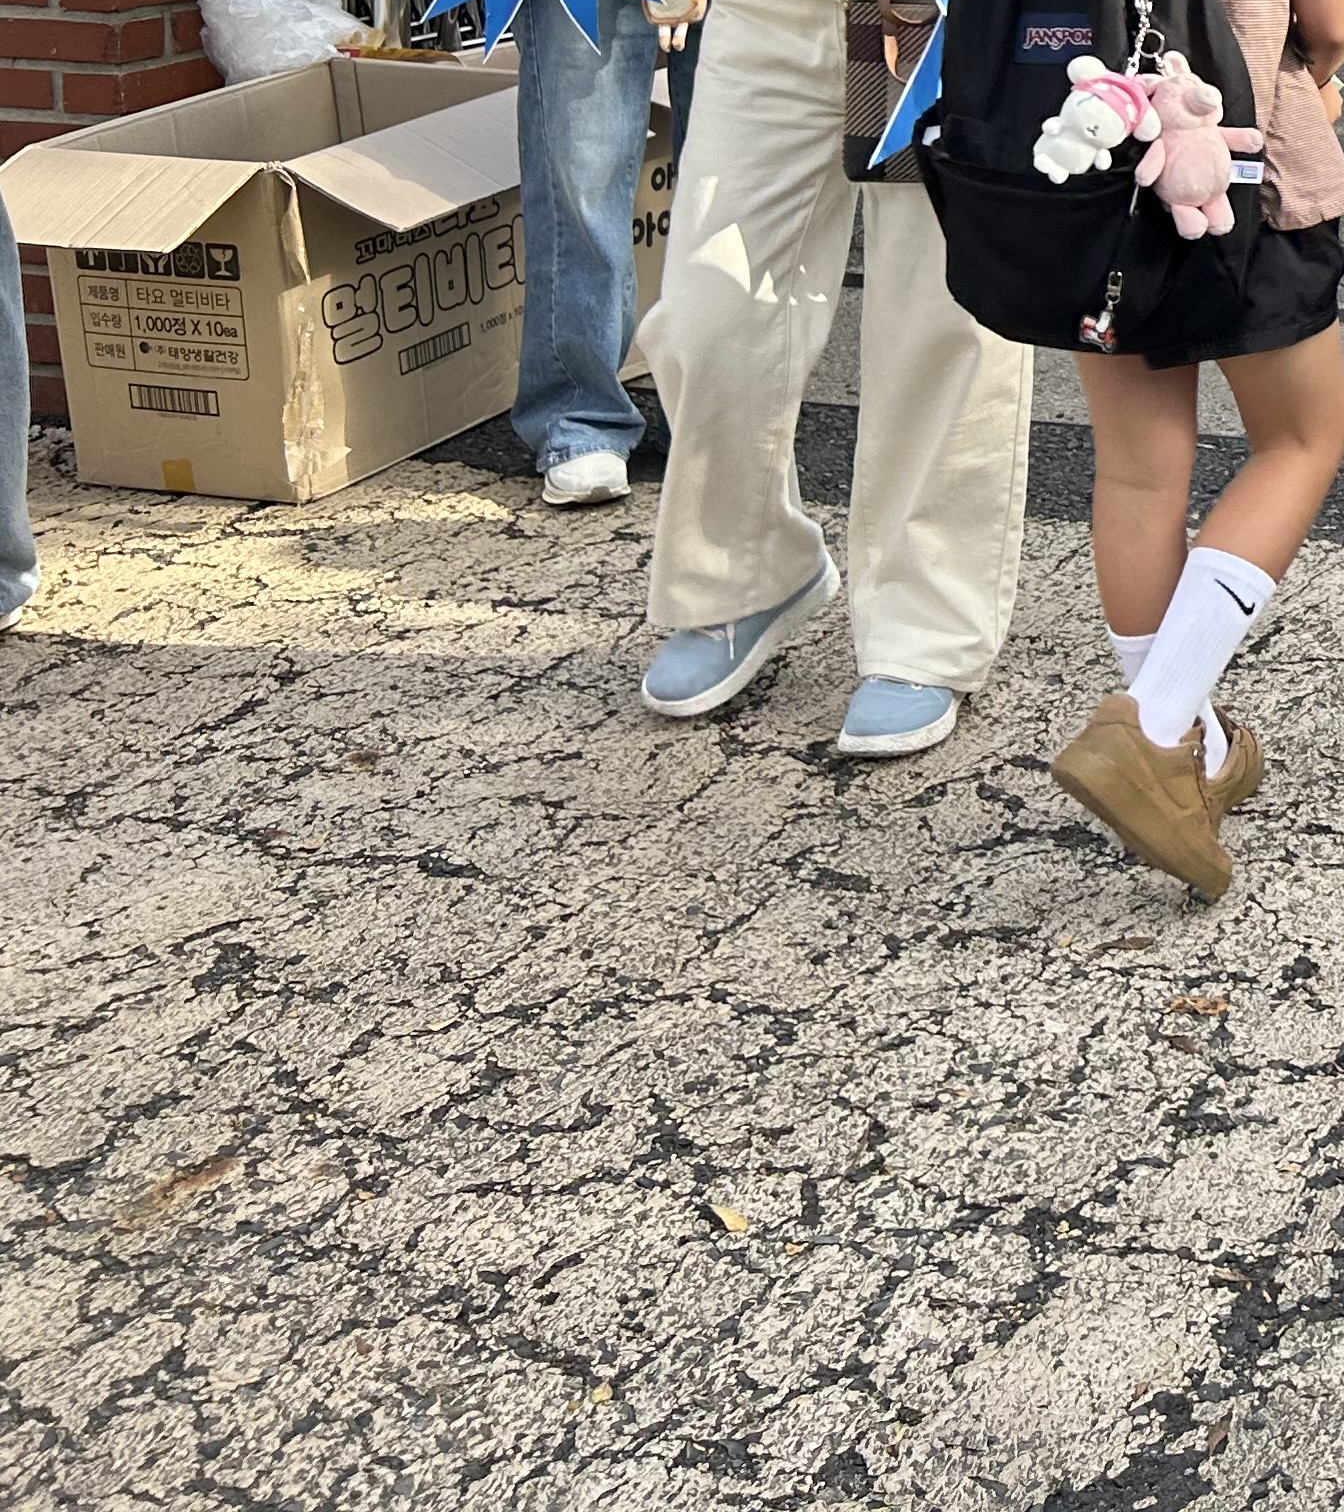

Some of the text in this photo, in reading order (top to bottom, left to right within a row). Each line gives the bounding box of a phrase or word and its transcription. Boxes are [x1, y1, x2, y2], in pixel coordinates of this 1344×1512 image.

[88, 285, 231, 312] 제품명 타요 멀티비타
[89, 311, 122, 329] 입수량
[133, 316, 186, 336] 1,000정
[206, 321, 239, 338] 10ea
[94, 343, 127, 359] 판매원
